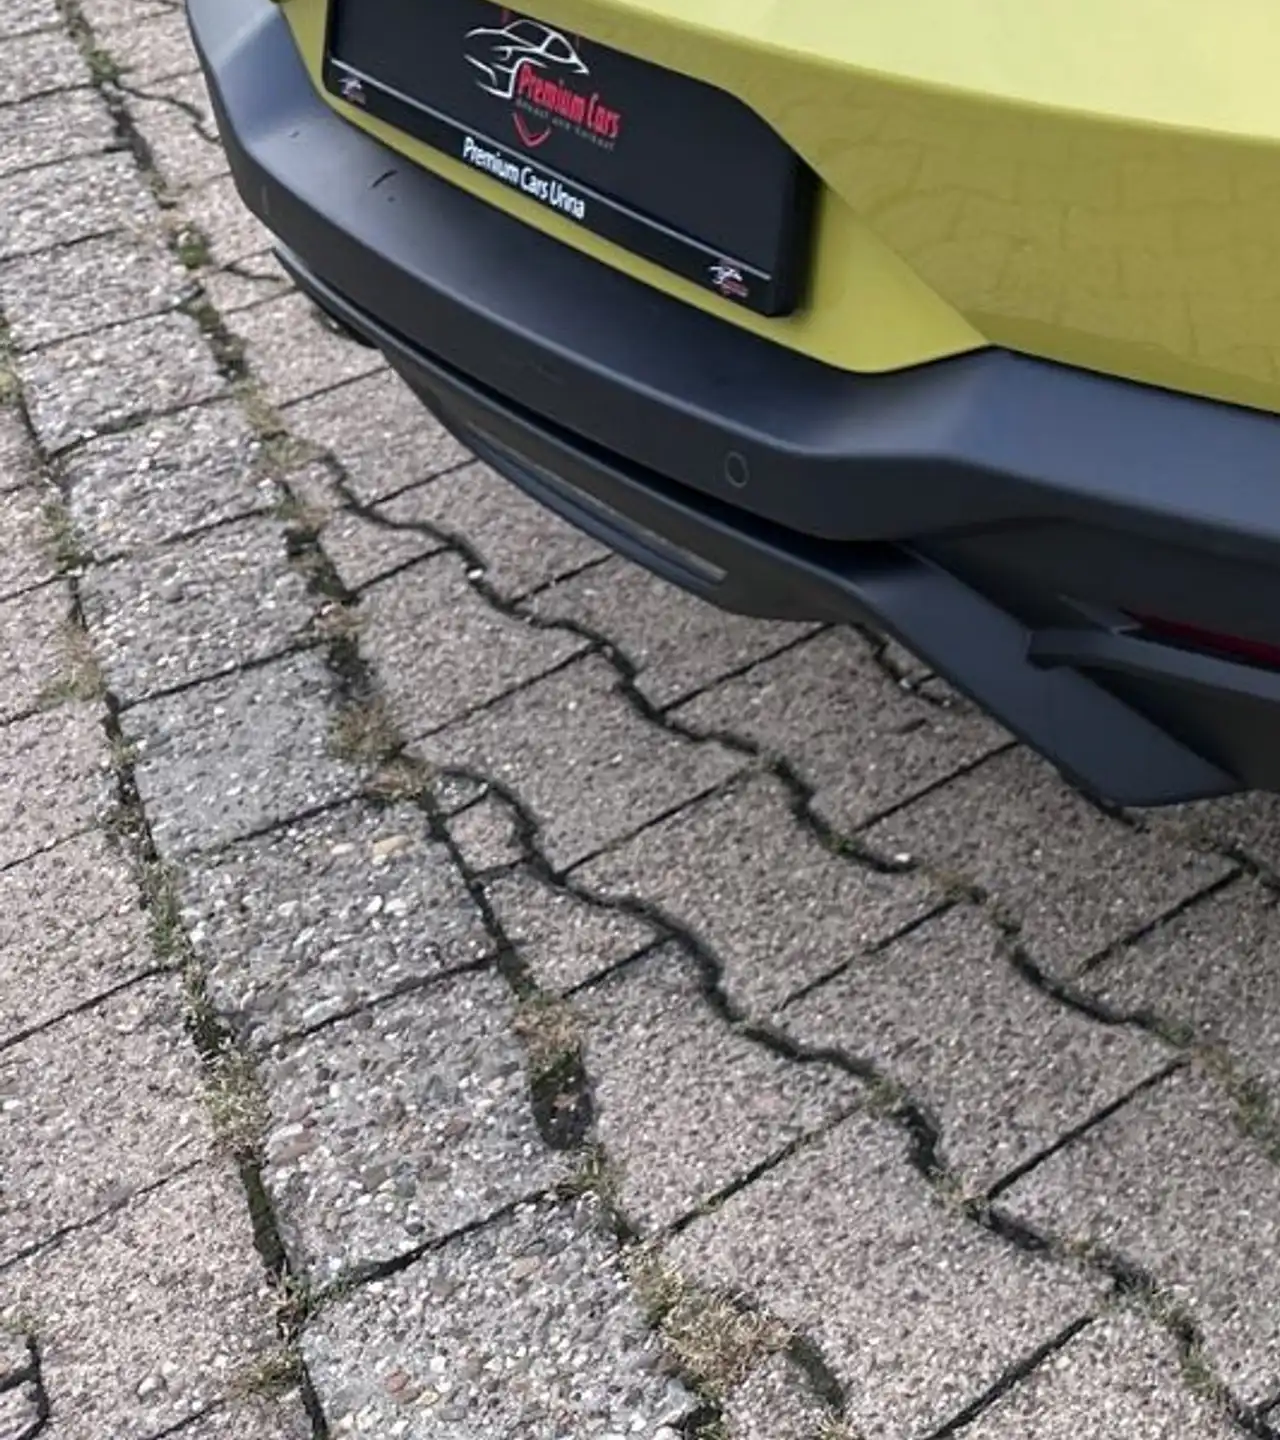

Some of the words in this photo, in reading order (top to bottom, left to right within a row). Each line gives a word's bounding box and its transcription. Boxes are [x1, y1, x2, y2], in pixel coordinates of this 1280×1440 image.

[518, 62, 586, 124] Premium
[587, 92, 621, 139] Cars
[463, 136, 519, 186] Premium
[520, 166, 549, 200] Cars
[549, 180, 585, 220] Unna
